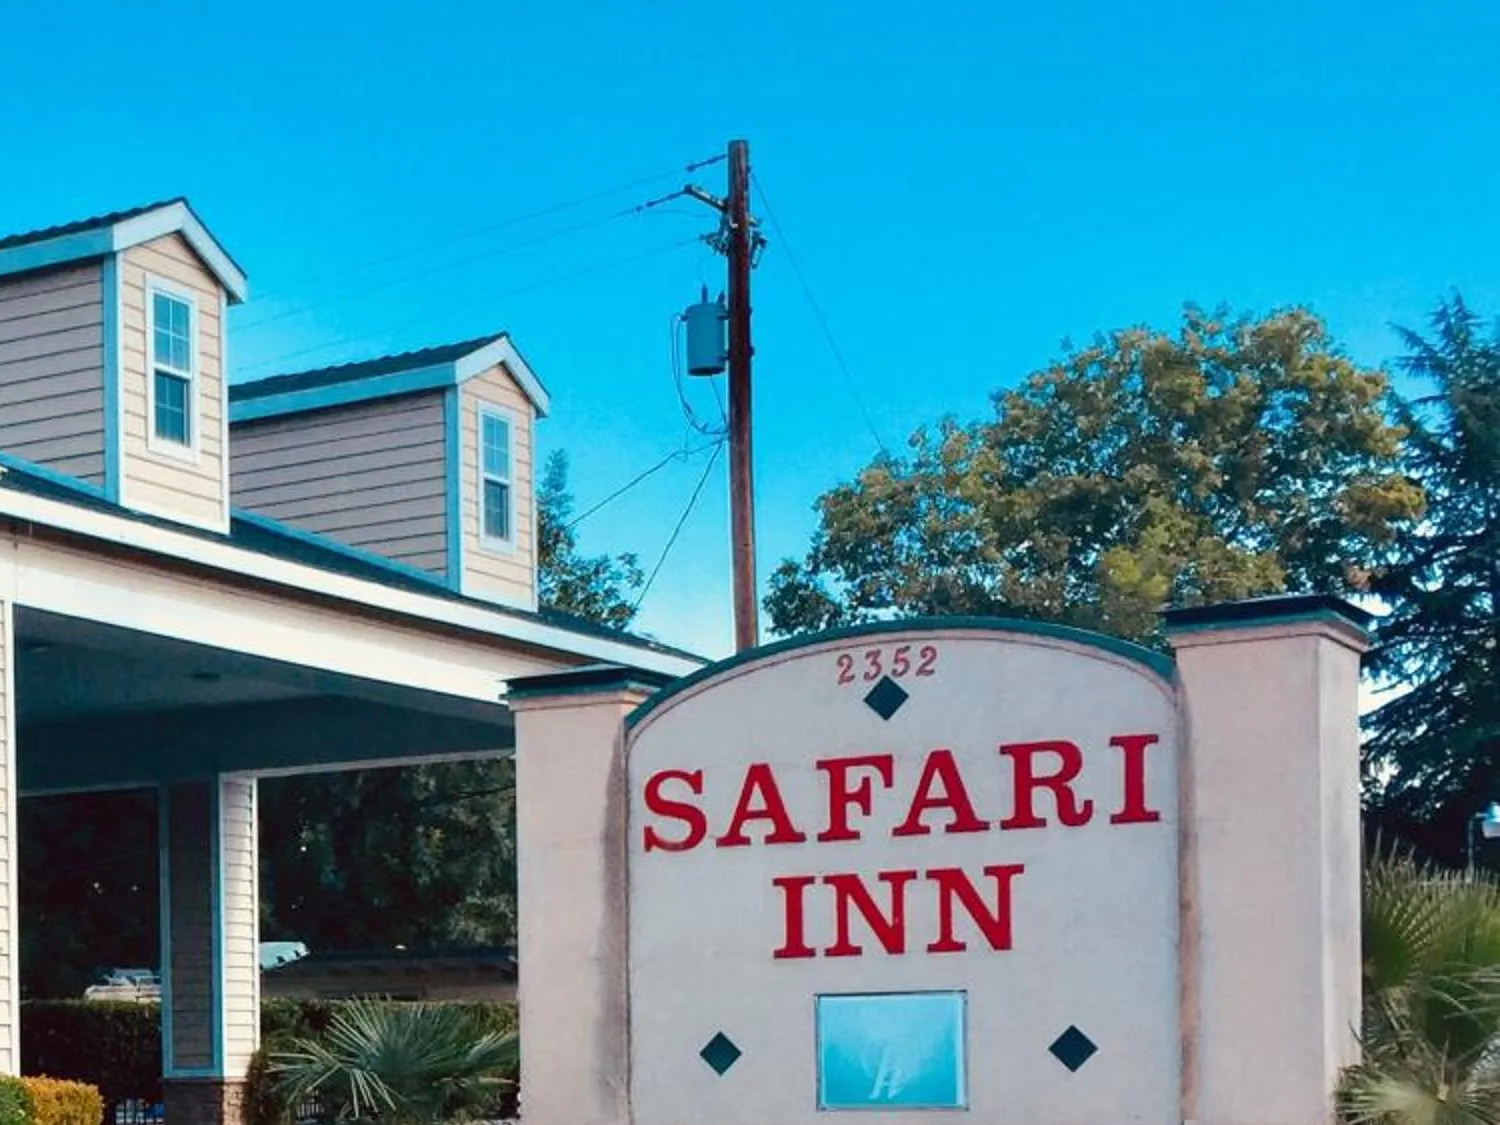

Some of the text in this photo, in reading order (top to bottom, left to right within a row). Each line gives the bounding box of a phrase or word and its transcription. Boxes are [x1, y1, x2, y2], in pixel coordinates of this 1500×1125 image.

[836, 645, 937, 685] 2352
[643, 734, 1160, 852] SAFARI
[772, 864, 1025, 958] INN
